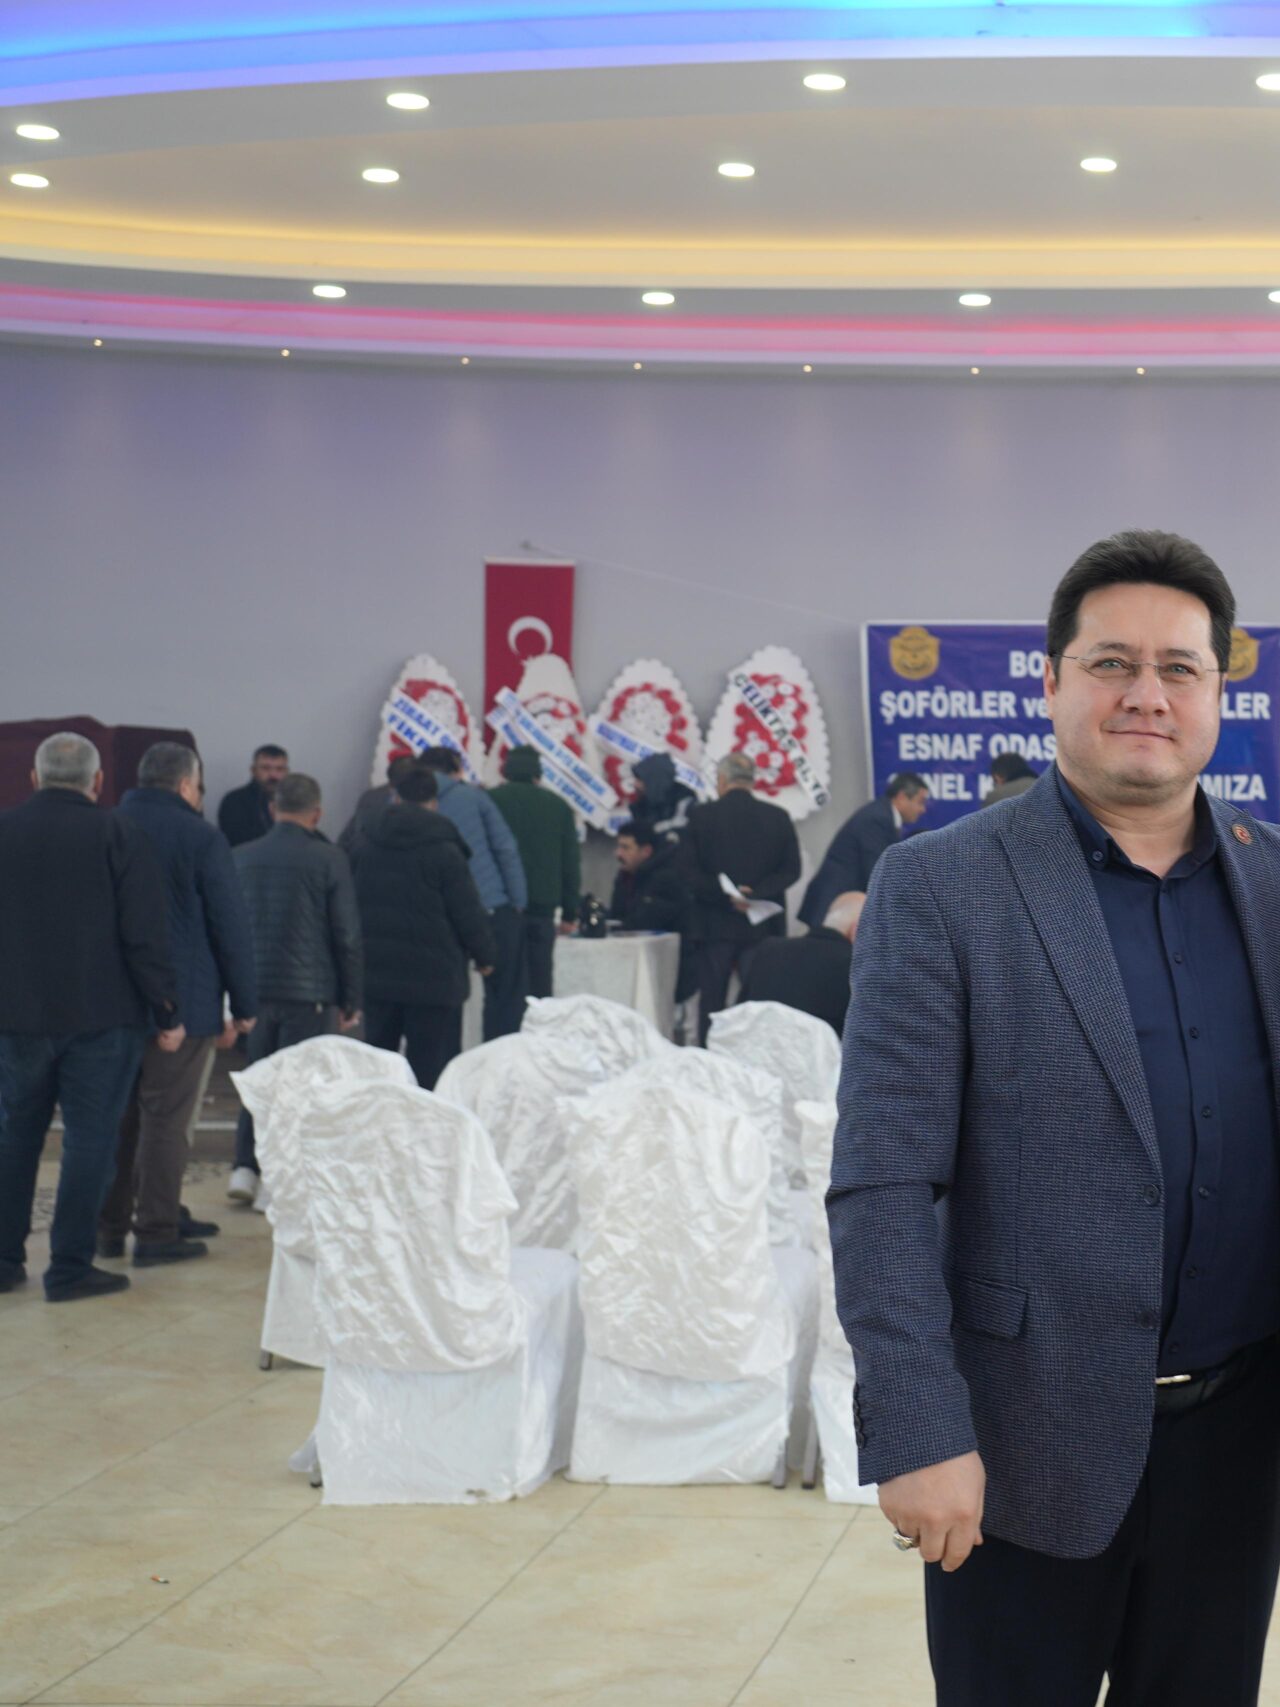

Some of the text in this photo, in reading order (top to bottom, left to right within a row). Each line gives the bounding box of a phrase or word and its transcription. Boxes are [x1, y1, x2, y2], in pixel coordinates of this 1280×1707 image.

[1010, 651, 1045, 678] BO
[880, 686, 1271, 725] ŞOFÖRLER ve LER
[899, 734, 1058, 762] ESNAF ODAS
